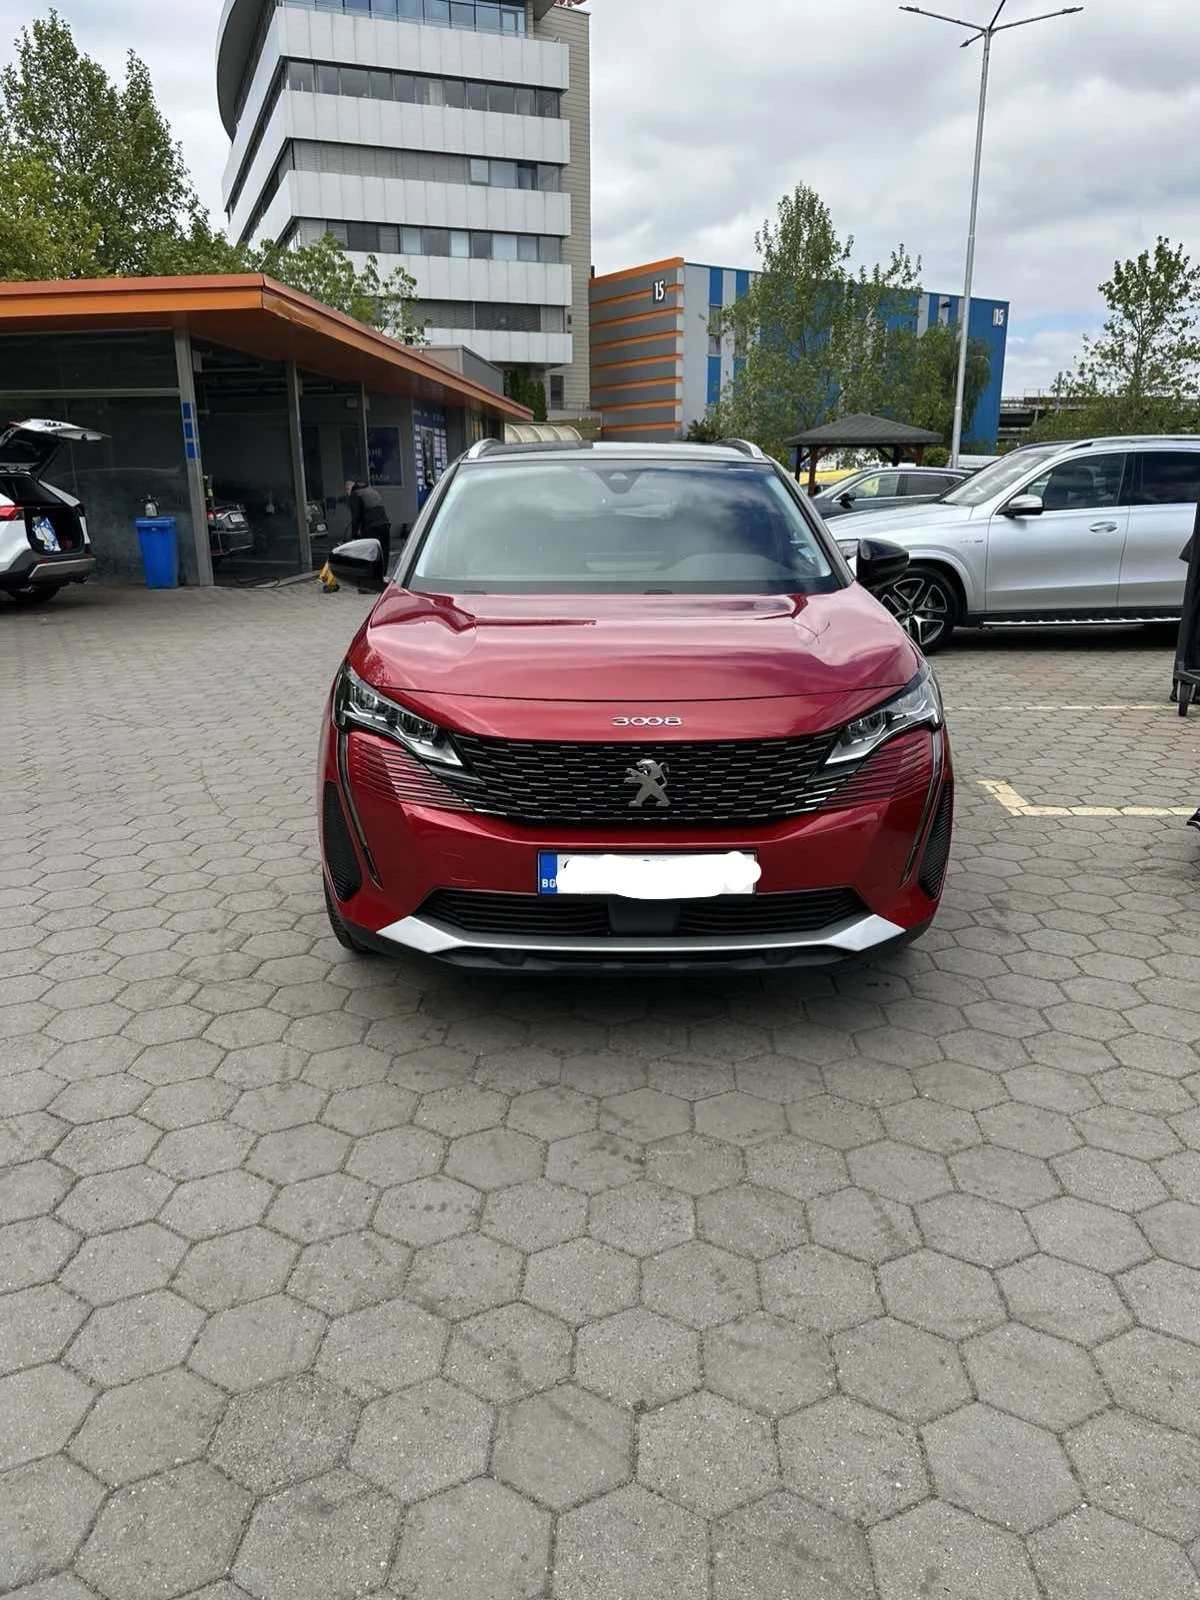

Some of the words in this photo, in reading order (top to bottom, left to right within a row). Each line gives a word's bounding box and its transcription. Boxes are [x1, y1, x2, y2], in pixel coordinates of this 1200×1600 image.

[654, 280, 664, 300] 15
[994, 308, 1004, 325] 15
[612, 716, 682, 726] 3008
[542, 878, 556, 888] BG
